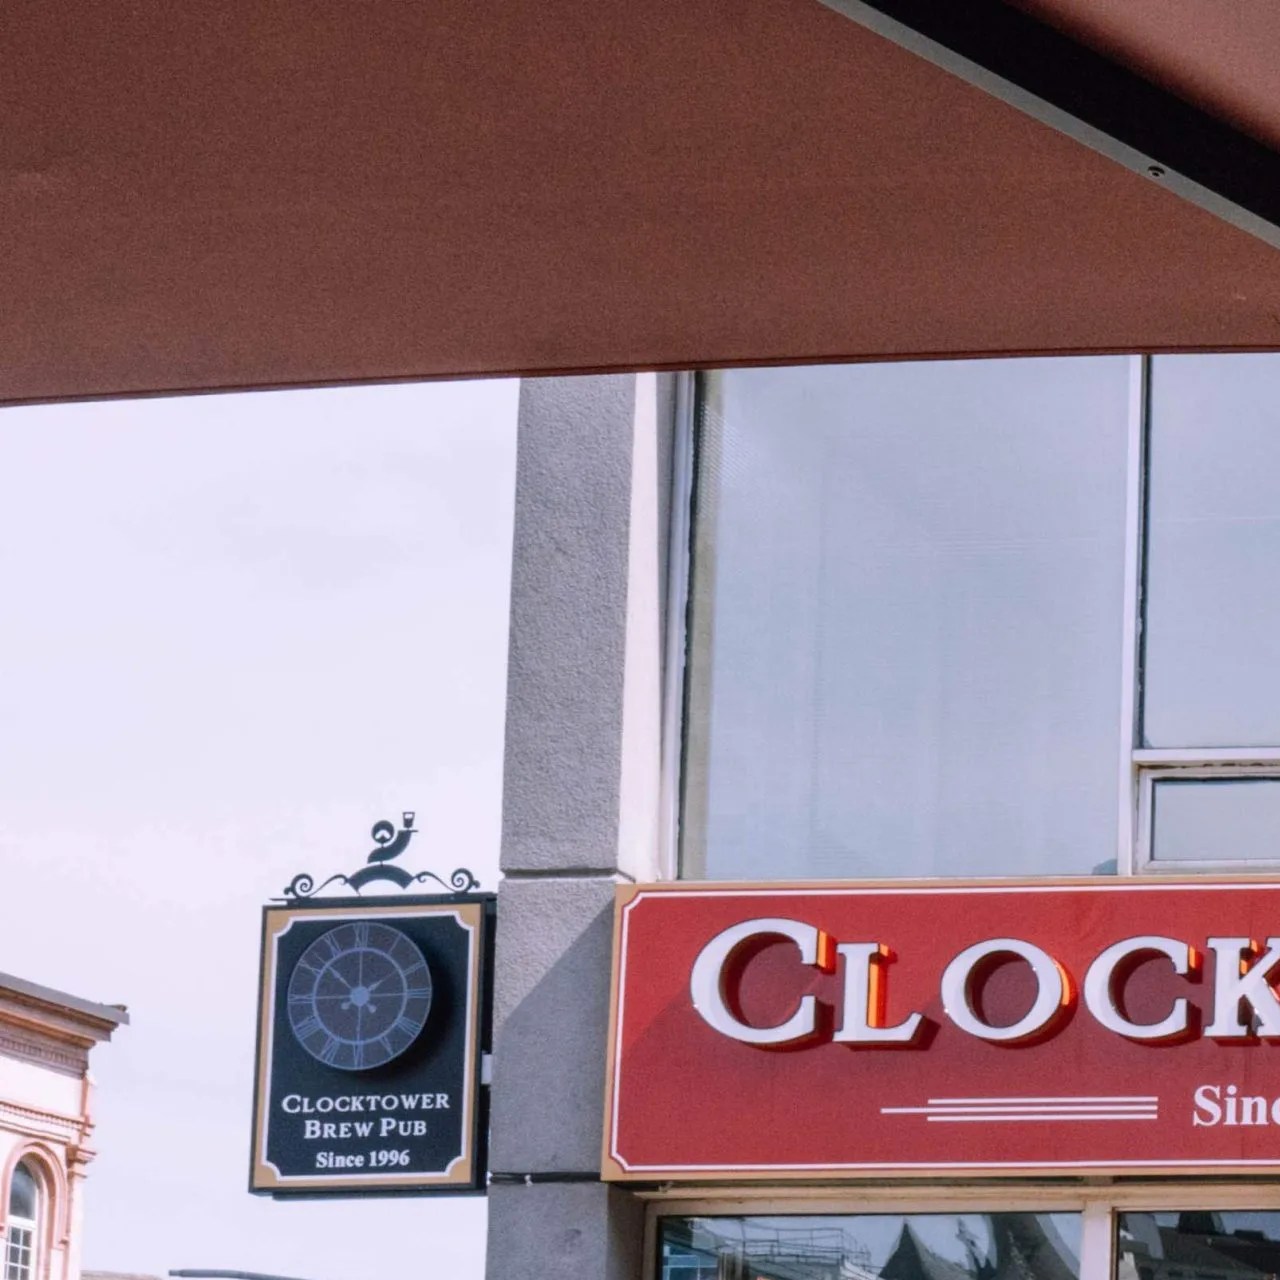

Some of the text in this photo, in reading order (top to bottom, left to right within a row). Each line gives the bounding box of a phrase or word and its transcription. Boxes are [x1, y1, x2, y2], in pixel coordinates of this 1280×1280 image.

[281, 1093, 450, 1114] CLOCKTOWER
[304, 1117, 427, 1140] BREW PUB
[316, 1149, 411, 1168] Since 1996
